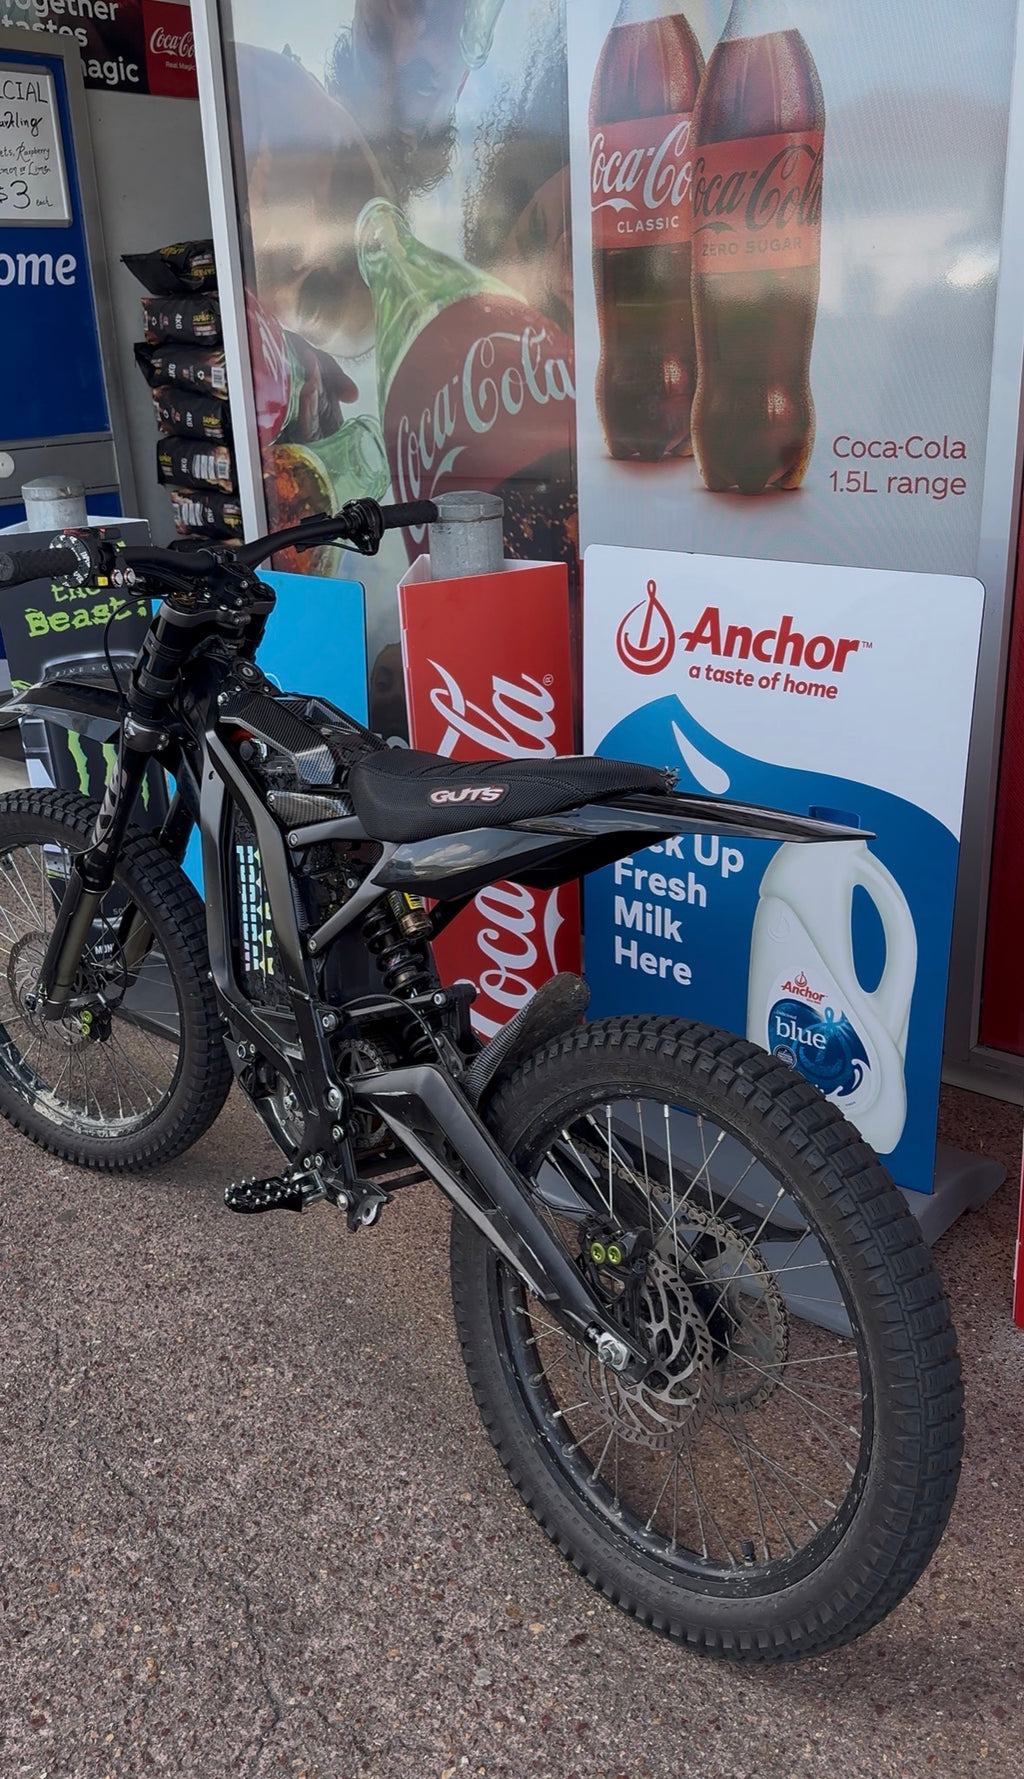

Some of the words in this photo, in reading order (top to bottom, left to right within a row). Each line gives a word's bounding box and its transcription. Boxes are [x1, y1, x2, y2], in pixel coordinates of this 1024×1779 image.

[150, 26, 196, 57] Coca-Co
[0, 79, 48, 104] CIAL
[590, 119, 693, 211] Coca-Co
[617, 215, 680, 234] CLASSIC
[702, 242, 739, 257] ZERO
[745, 237, 803, 254] SUGAR
[832, 435, 967, 460] Coca-Cola
[829, 470, 878, 493] 1.5L
[886, 476, 967, 500] range
[688, 665, 701, 679] a
[705, 664, 755, 687] taste
[758, 671, 782, 691] of
[783, 673, 838, 700] home
[429, 785, 504, 804] GUTS
[694, 834, 744, 878] Up
[614, 855, 707, 908] Fresh
[614, 895, 683, 943] Milk
[614, 935, 692, 986] Here
[781, 980, 826, 1003] Anchor
[775, 1016, 827, 1050] blue
